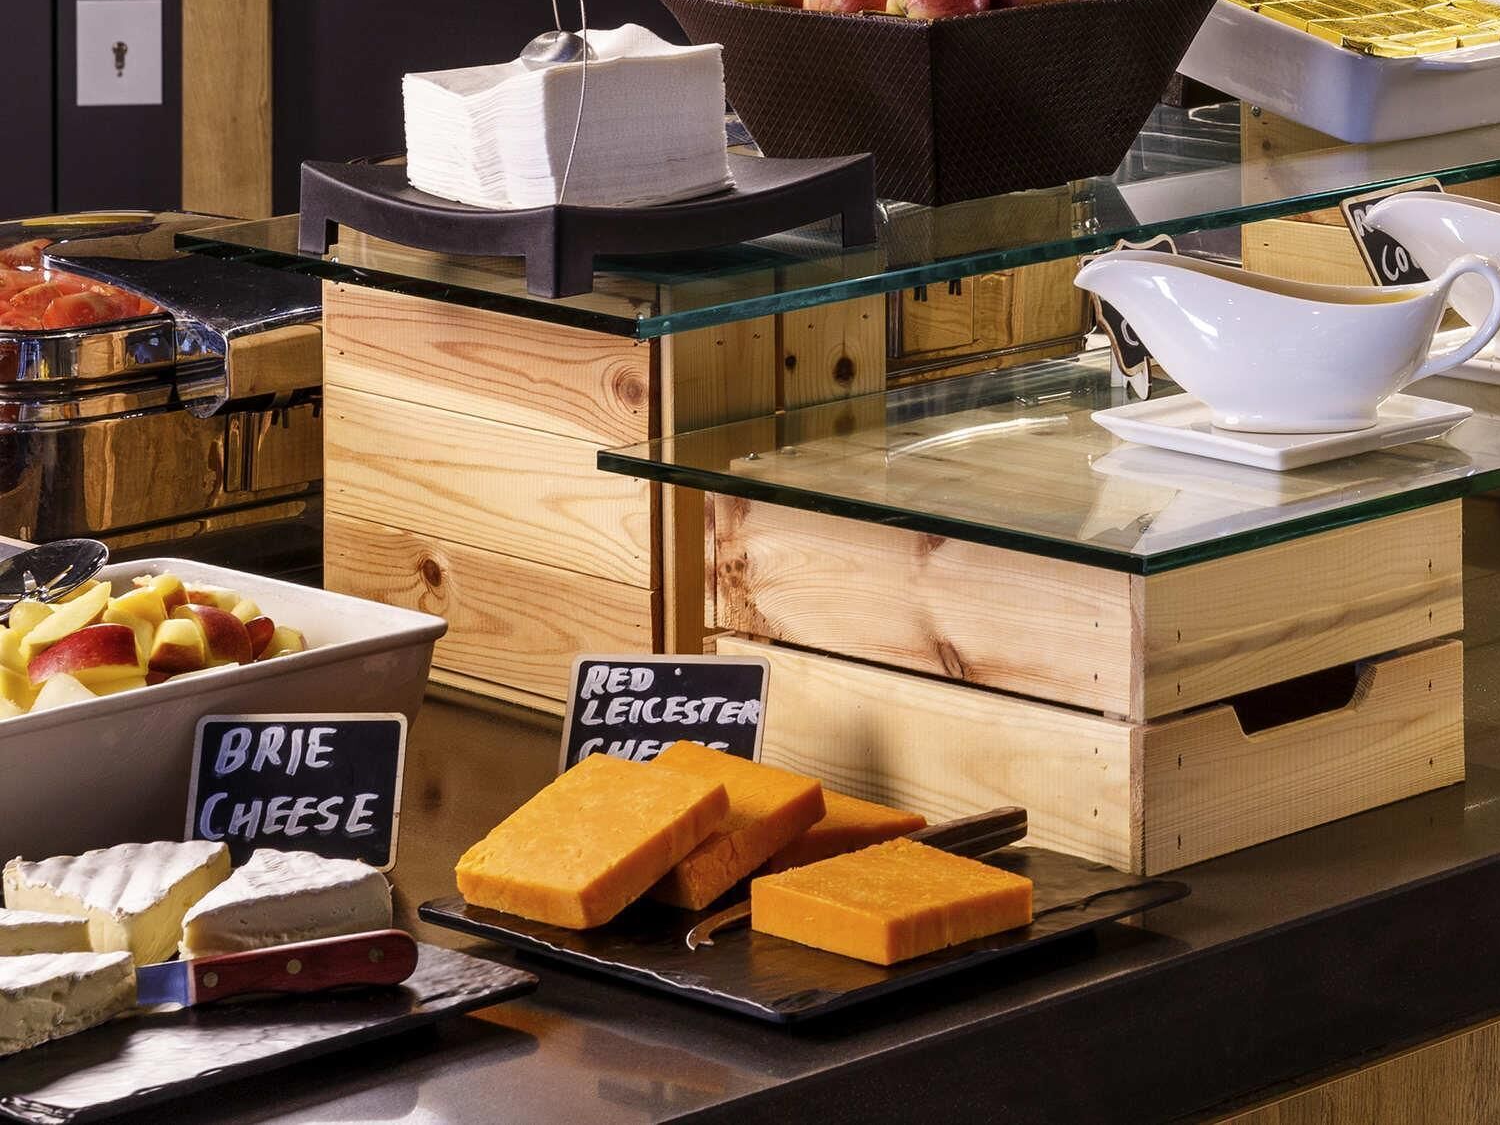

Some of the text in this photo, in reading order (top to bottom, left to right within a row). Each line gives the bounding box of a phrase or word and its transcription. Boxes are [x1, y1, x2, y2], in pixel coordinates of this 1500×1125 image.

[580, 664, 655, 700] RED
[580, 696, 761, 726] LEICESTER
[214, 726, 338, 776] BRIE
[200, 792, 380, 841] CHEESE
